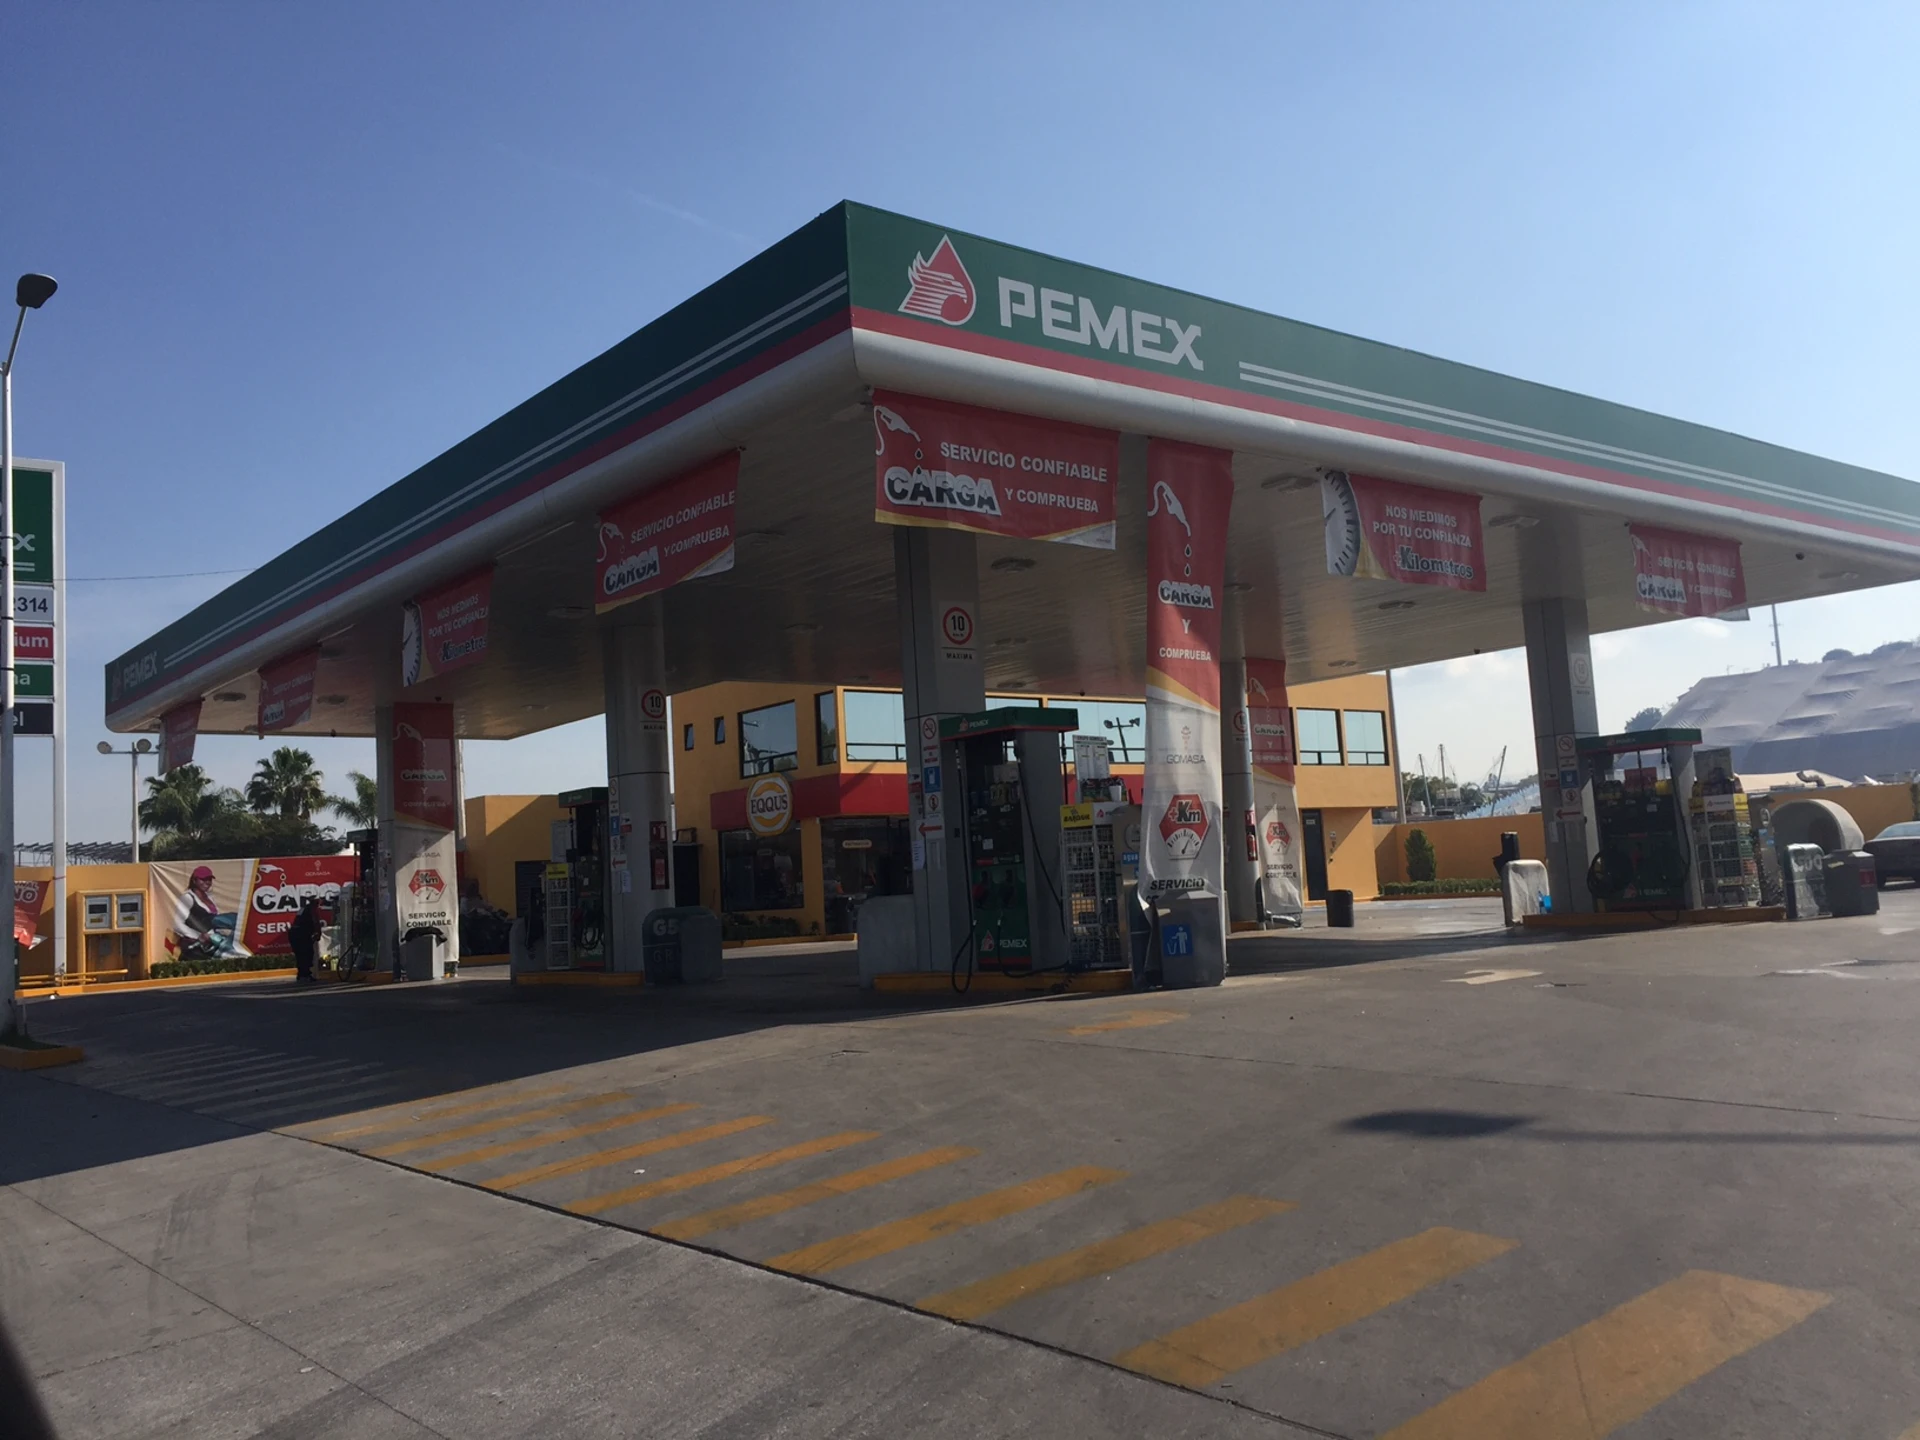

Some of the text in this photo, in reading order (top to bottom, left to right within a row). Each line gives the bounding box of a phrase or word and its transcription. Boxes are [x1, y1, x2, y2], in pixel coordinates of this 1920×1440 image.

[998, 276, 1204, 372] PEMEX
[940, 441, 1108, 483] SERVICIO CONFIABLE
[884, 467, 1000, 515] CARGA
[1004, 487, 1099, 514] Y COMPRUEBA
[630, 490, 736, 544] SERVICIO CONFIABLE
[1385, 505, 1457, 528] NOS MEDIMOS
[663, 525, 730, 557] Y COMPRUEBA
[1373, 521, 1472, 548] POR TU CONFIANZA
[604, 546, 660, 595] CARGA
[1158, 580, 1214, 609] CARGA
[1637, 573, 1687, 603] CARGA
[428, 625, 443, 638] POR
[951, 615, 965, 631] 10
[1182, 618, 1191, 634] Y
[1159, 646, 1212, 662] COMPRUEBA
[123, 652, 158, 692] PEMEX
[649, 695, 661, 708] 10
[1267, 741, 1273, 749] Y
[1165, 754, 1207, 765] GOMASA
[421, 786, 428, 795] Y
[750, 794, 788, 814] EQQUS
[1150, 878, 1205, 892] SERVICIO
[407, 918, 452, 928] CONFIABLE
[408, 911, 446, 920] SERVICIO
